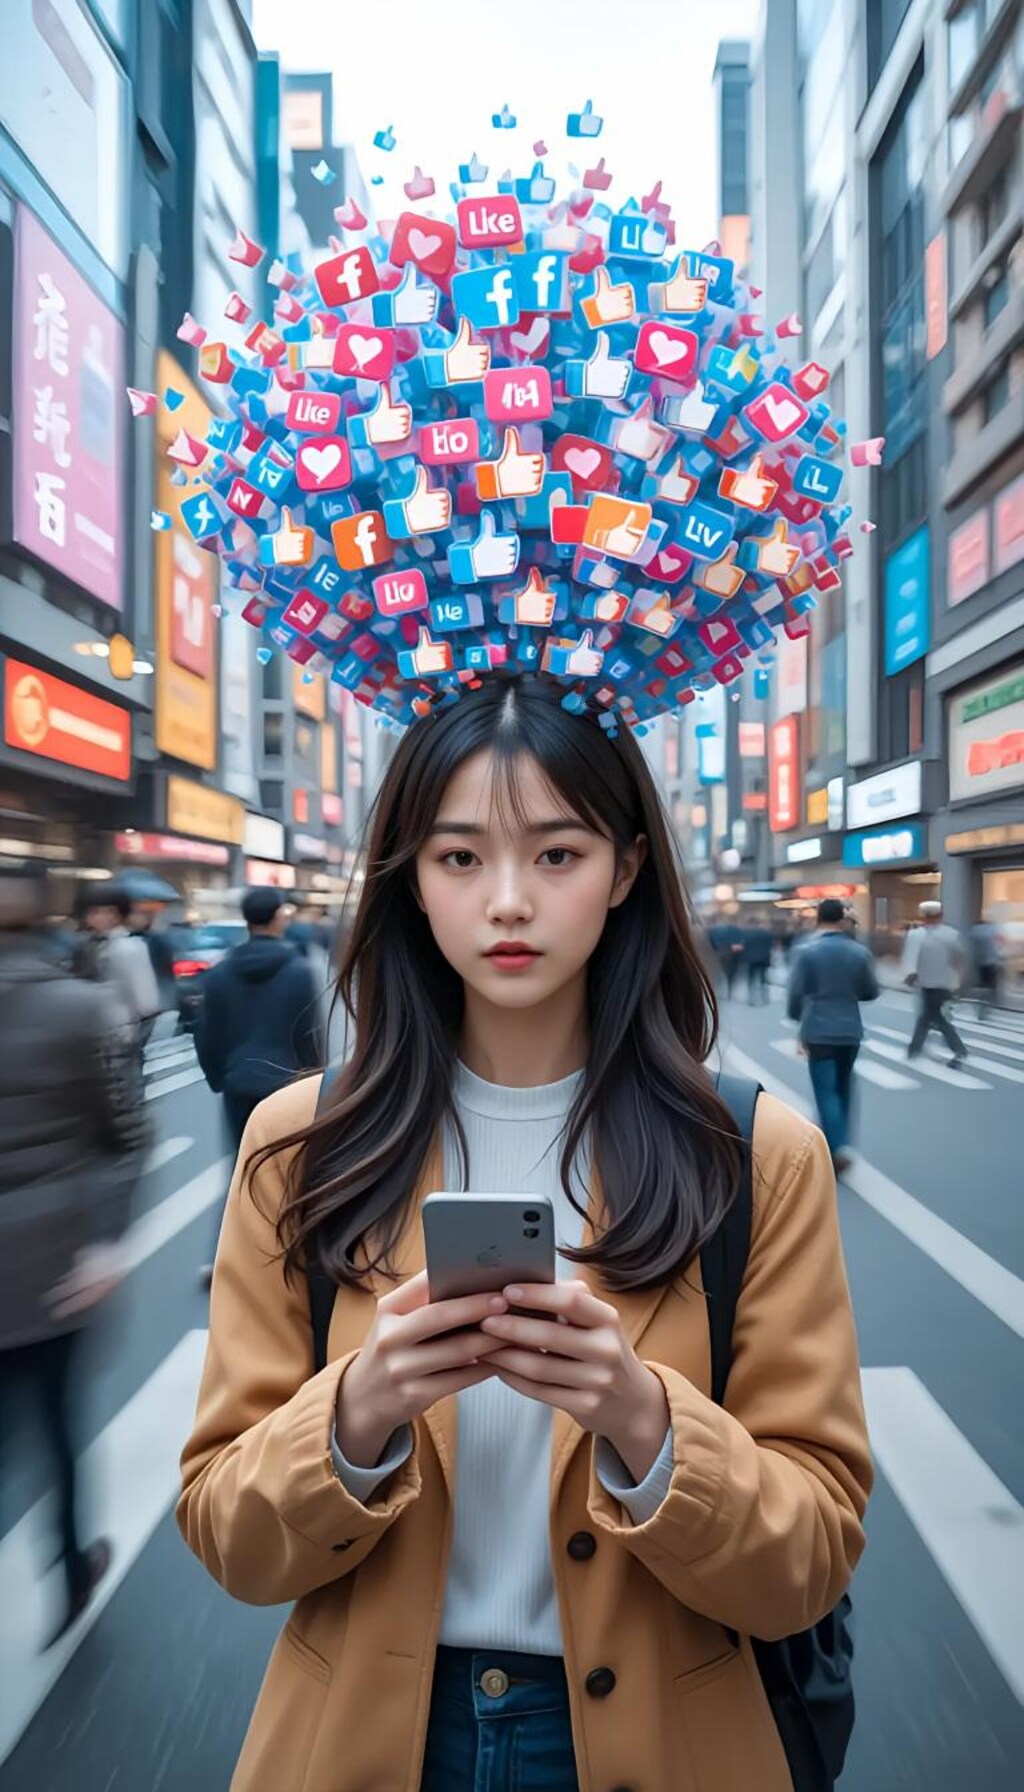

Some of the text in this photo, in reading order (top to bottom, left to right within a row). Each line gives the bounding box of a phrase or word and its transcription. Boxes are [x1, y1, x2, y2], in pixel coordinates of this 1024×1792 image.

[336, 254, 362, 300] f
[486, 269, 513, 326] f
[532, 255, 557, 308] f
[354, 515, 377, 566] f
